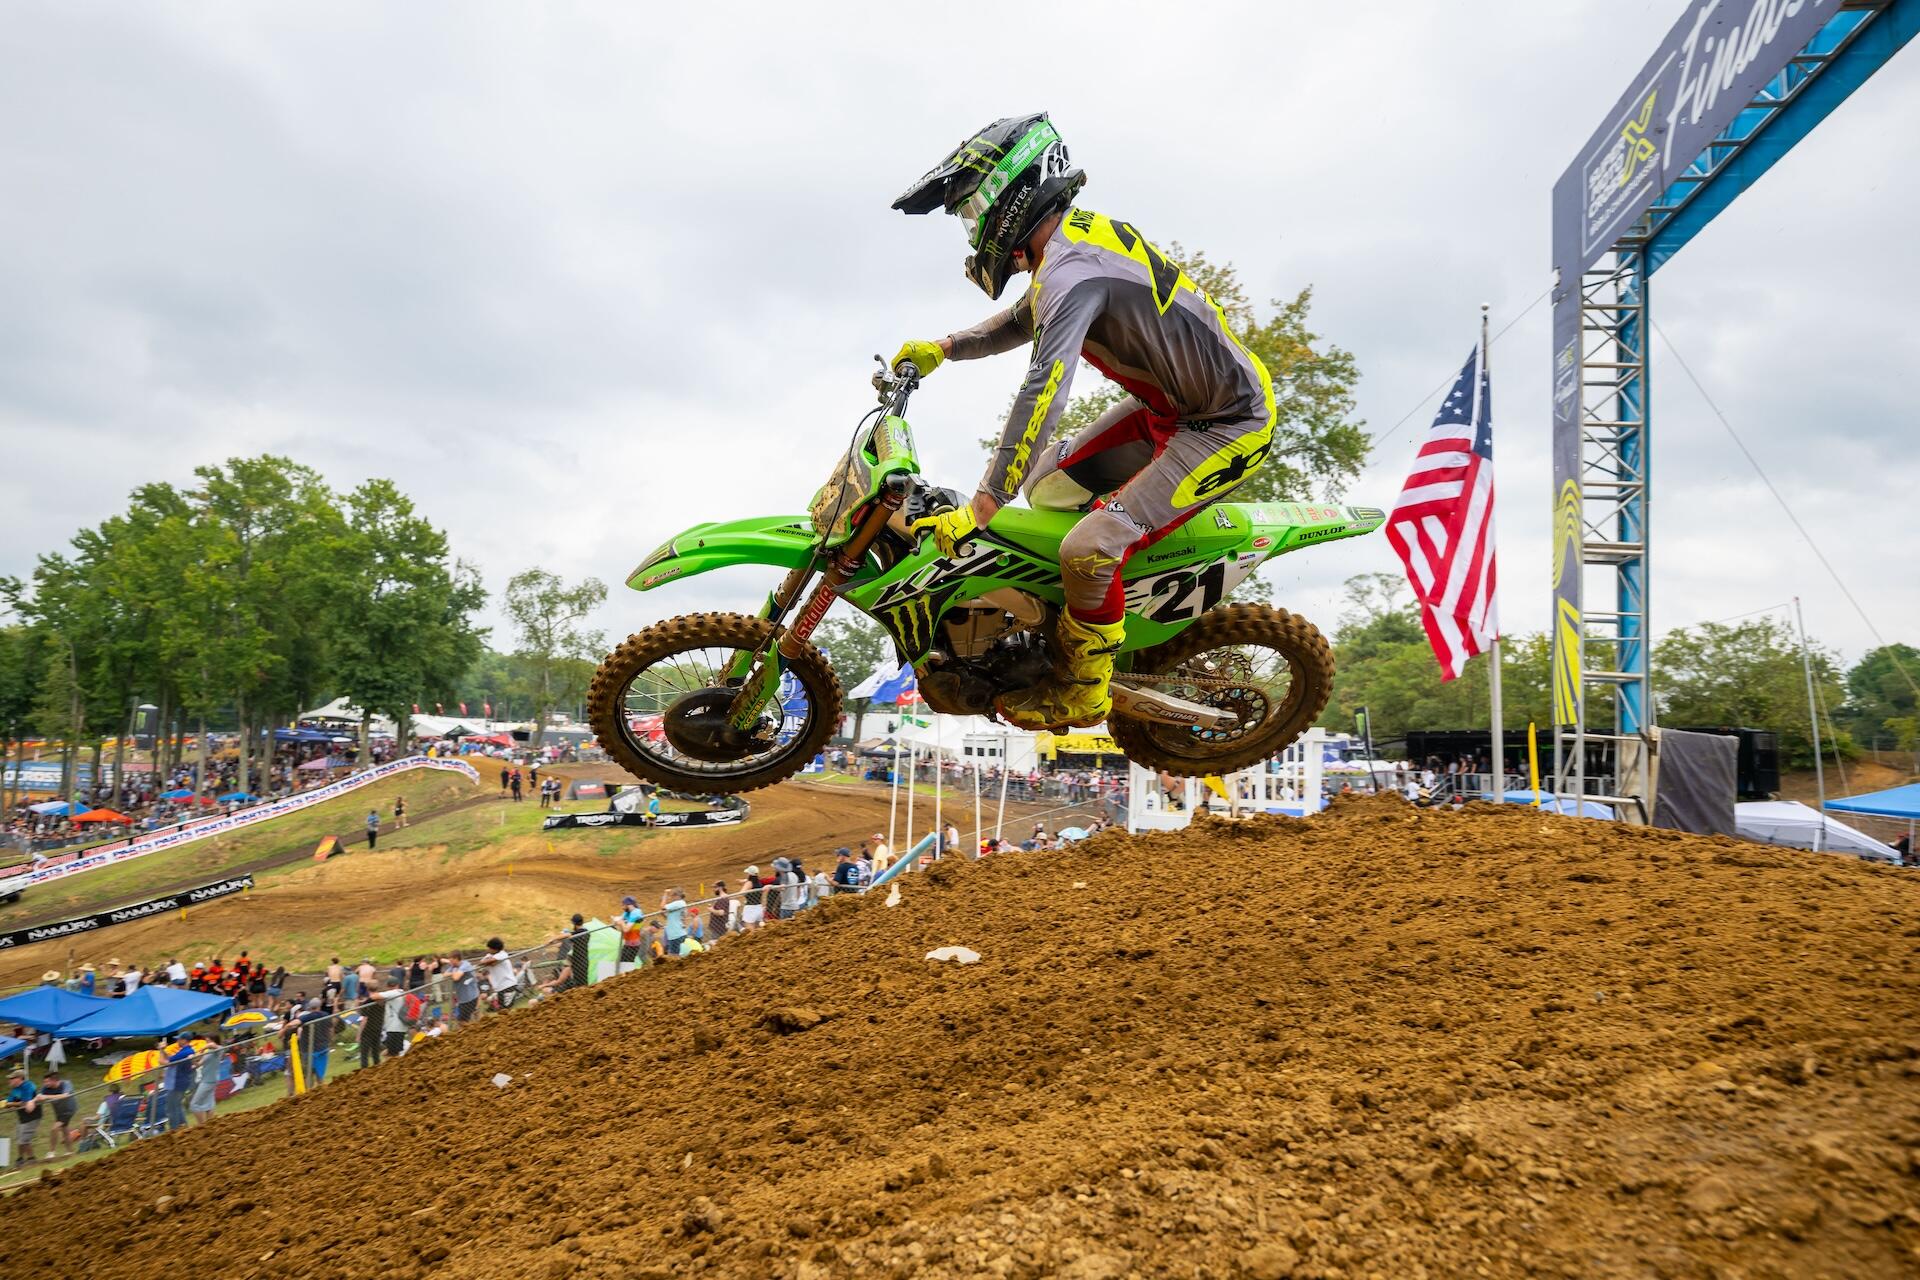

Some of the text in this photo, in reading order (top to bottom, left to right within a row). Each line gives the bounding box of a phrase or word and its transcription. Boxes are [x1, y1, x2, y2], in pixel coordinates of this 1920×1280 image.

[998, 185, 1032, 238] MONSTER
[1147, 546, 1196, 564] Kawasaki
[1299, 526, 1346, 541] DUNLOP
[797, 585, 836, 641] SHOWA
[1150, 562, 1224, 624] 21
[641, 814, 679, 826] TUMPH
[28, 879, 253, 939] NAMURA NAMURA NAMURA
